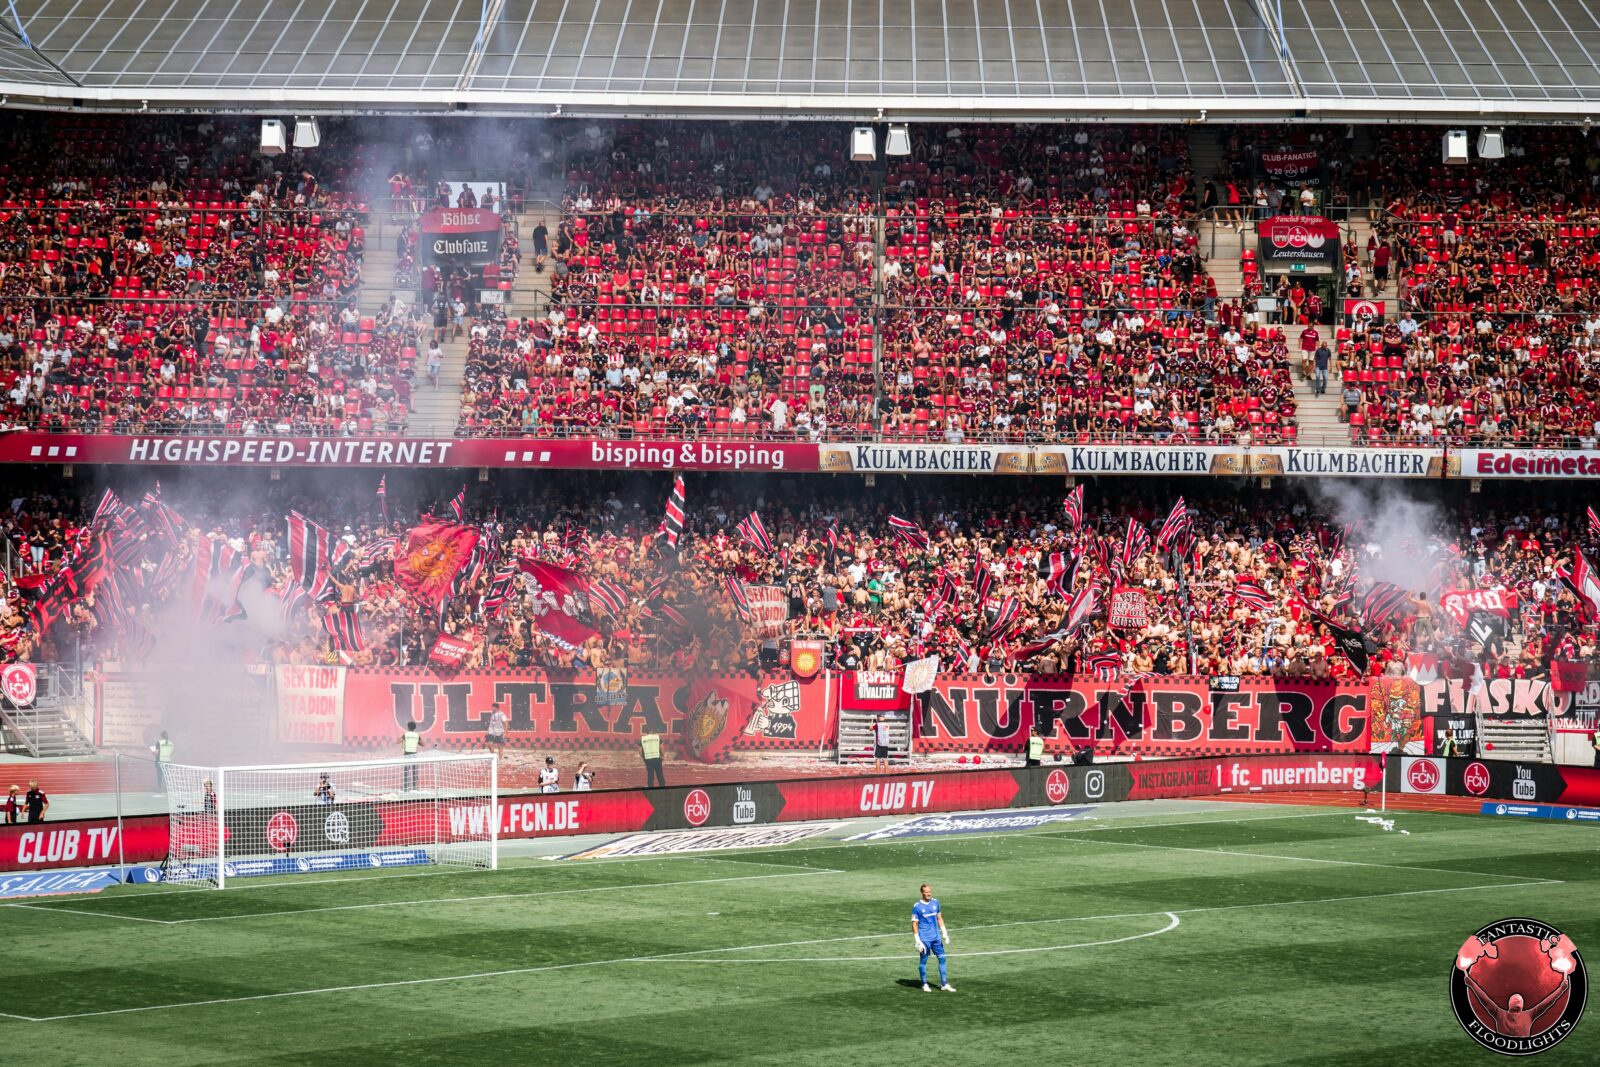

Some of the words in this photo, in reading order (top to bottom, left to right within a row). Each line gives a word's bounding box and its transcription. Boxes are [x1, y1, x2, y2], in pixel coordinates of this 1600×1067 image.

[1262, 151, 1317, 162] CLUB-FANATICS
[441, 212, 481, 227] Böhse
[433, 239, 489, 254] Clubfanz
[1272, 249, 1325, 258] Leutershausen
[129, 439, 452, 464] HIGHSPEED-INTERNET
[591, 442, 674, 468] bisping
[679, 443, 697, 463] &
[701, 443, 784, 470] bisping
[856, 445, 992, 470] KULMBACHER
[1071, 447, 1207, 471] KULMBACHER
[1286, 449, 1424, 474] KULMBACHER
[1111, 616, 1146, 627] KURVE
[282, 665, 338, 689] SEKTION
[857, 671, 896, 683] RESPEKT
[282, 694, 336, 715] STADION
[1424, 678, 1572, 716] FIASKO
[915, 674, 1367, 745] NÜRNBERG
[283, 721, 335, 742] VERBOT
[773, 716, 793, 732] 1994
[1448, 720, 1465, 730] YOU
[1458, 730, 1475, 739] LIVE
[1411, 772, 1435, 784] FCN
[1516, 765, 1532, 780] You
[1048, 782, 1066, 795] FCN
[1467, 775, 1487, 788] FCN
[1514, 781, 1535, 797] Tube
[736, 787, 751, 801] You
[860, 783, 905, 811] CLUB
[911, 781, 934, 807] TV
[687, 804, 708, 816] FCN
[735, 804, 755, 820] Tube
[270, 828, 293, 842] FCN
[18, 829, 81, 864] CLUB
[87, 827, 119, 859] TV
